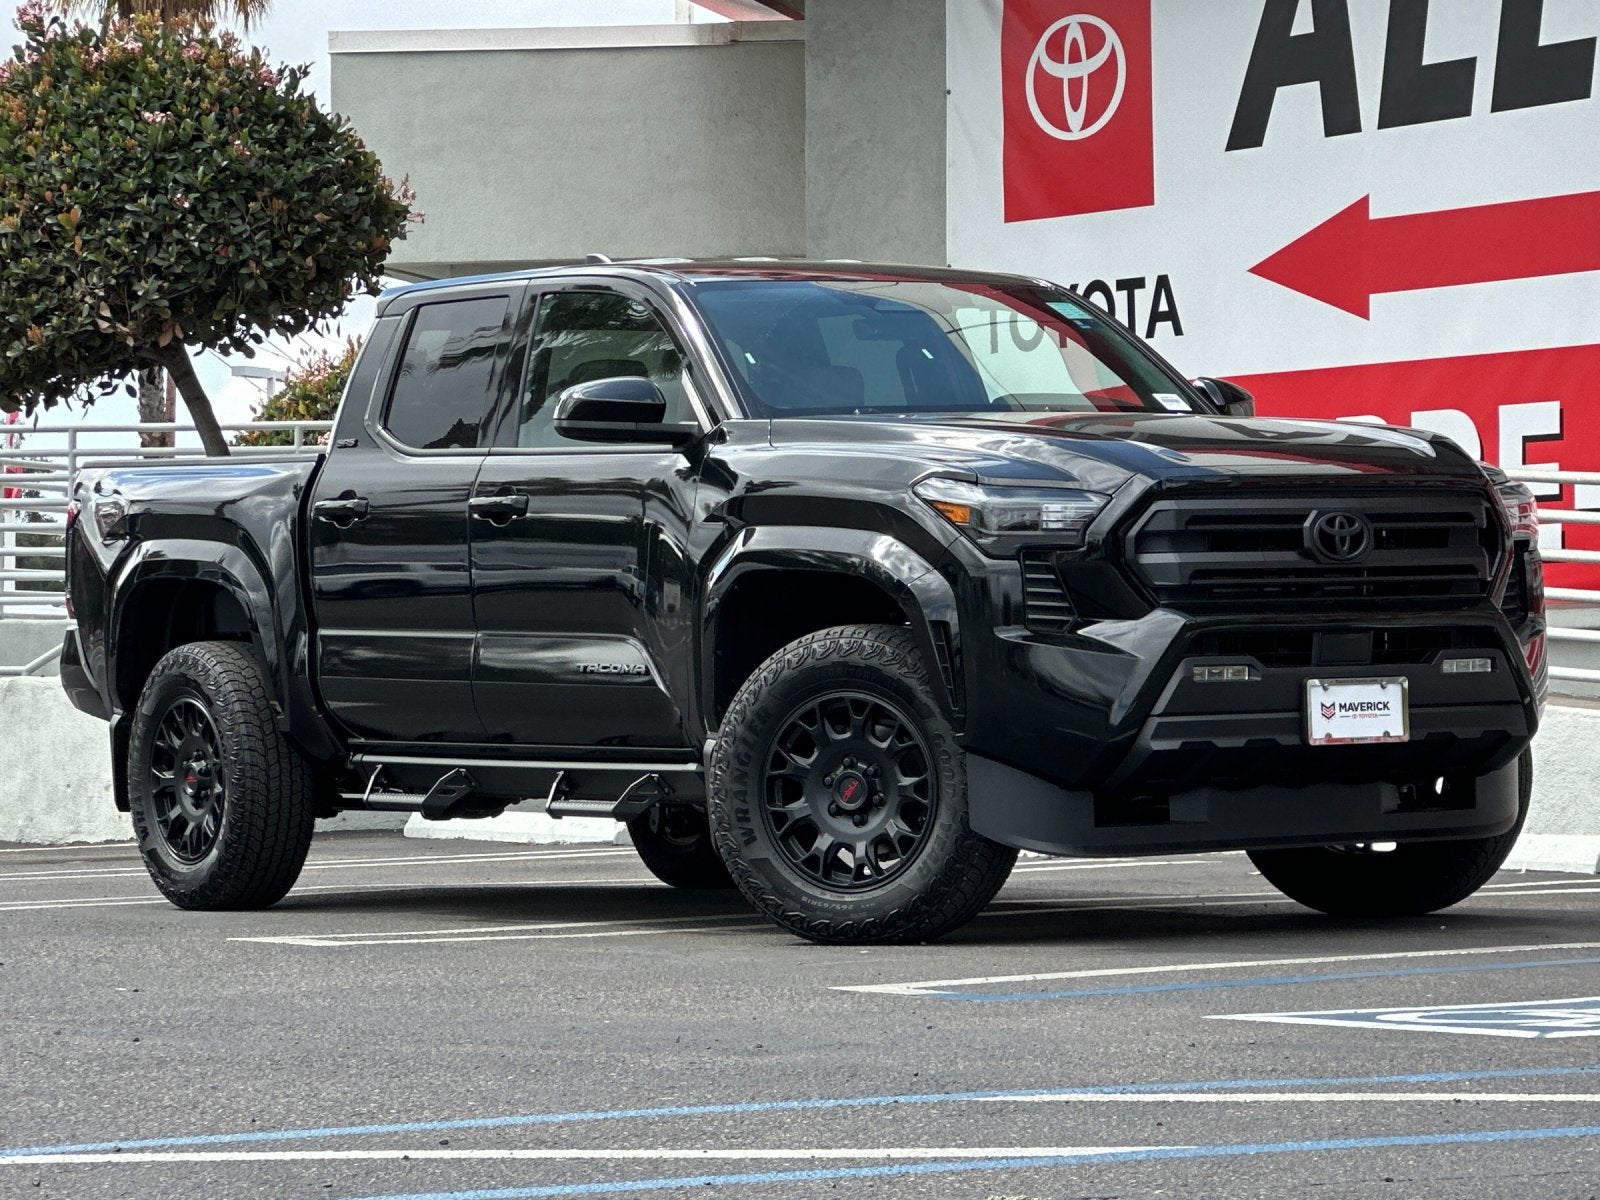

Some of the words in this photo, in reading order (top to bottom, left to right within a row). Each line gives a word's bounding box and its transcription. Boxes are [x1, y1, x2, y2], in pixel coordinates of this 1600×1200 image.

[576, 663, 646, 674] TACOMA
[1339, 701, 1391, 712] MAVERICK
[732, 705, 772, 846] WRANGLER
